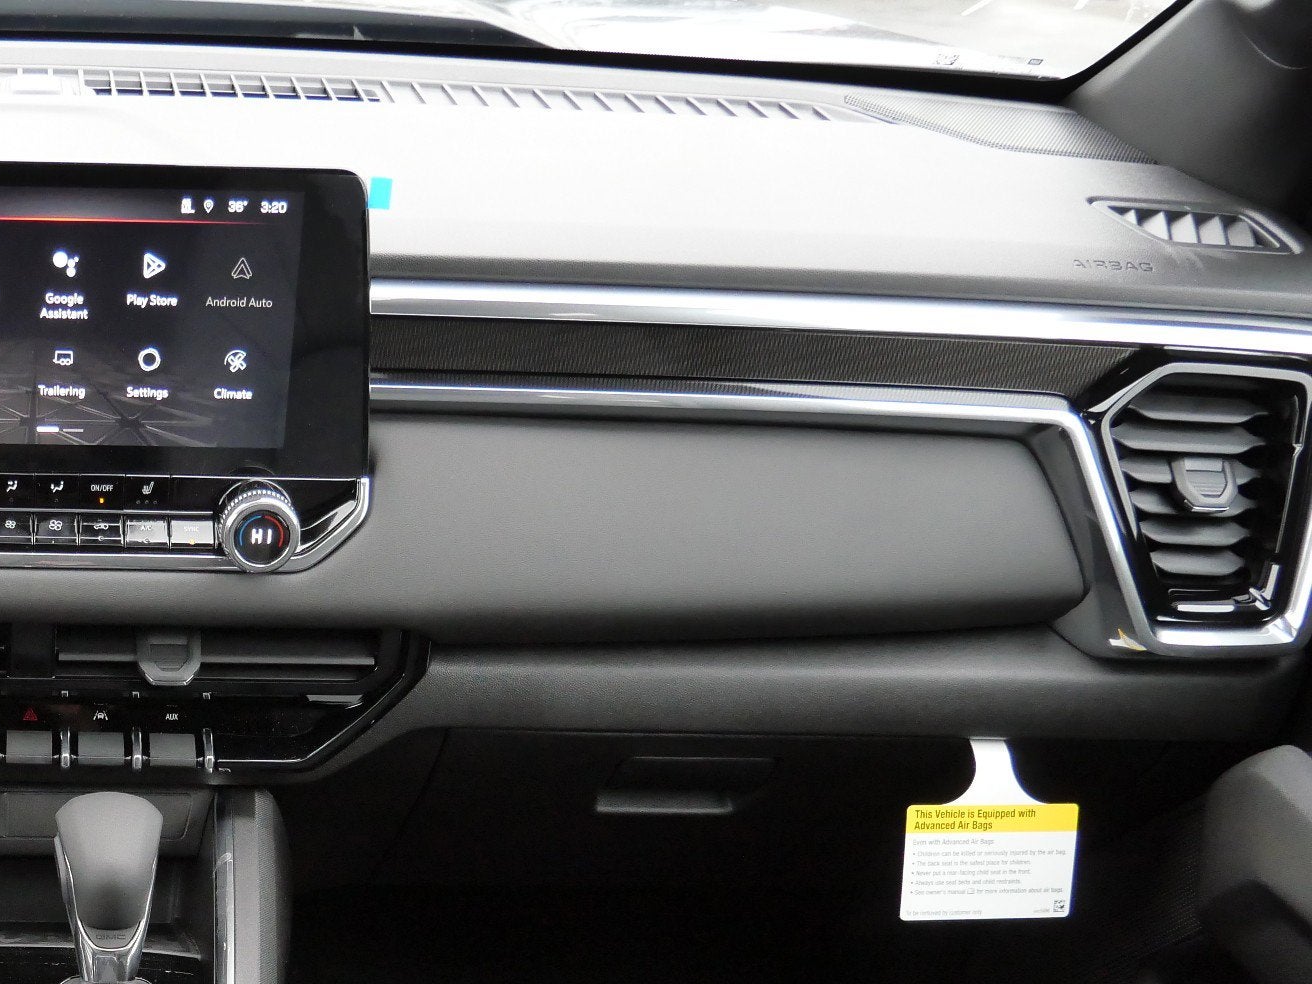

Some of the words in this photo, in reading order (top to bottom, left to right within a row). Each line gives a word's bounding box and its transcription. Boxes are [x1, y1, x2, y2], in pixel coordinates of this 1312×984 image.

[260, 200, 288, 214] 3:20
[1072, 259, 1153, 272] AIRBAG
[46, 293, 83, 307] Google
[127, 294, 146, 308] Play
[146, 294, 178, 307] Store
[205, 296, 243, 308] Android
[243, 296, 273, 308] Auto
[39, 307, 89, 320] Assistant
[38, 385, 85, 399] Trailering
[126, 386, 169, 401] Settings
[213, 387, 253, 400] Climate
[90, 484, 114, 492] ON/OFF
[251, 529, 272, 544] HI
[165, 713, 179, 721] AUX
[915, 809, 933, 818] This
[935, 809, 965, 818] Vehicle
[968, 808, 975, 818] is
[977, 808, 1015, 819] Equipped
[1018, 808, 1036, 817] with
[914, 820, 956, 829] Advanced
[957, 820, 970, 829] Air
[972, 820, 993, 831] Bags
